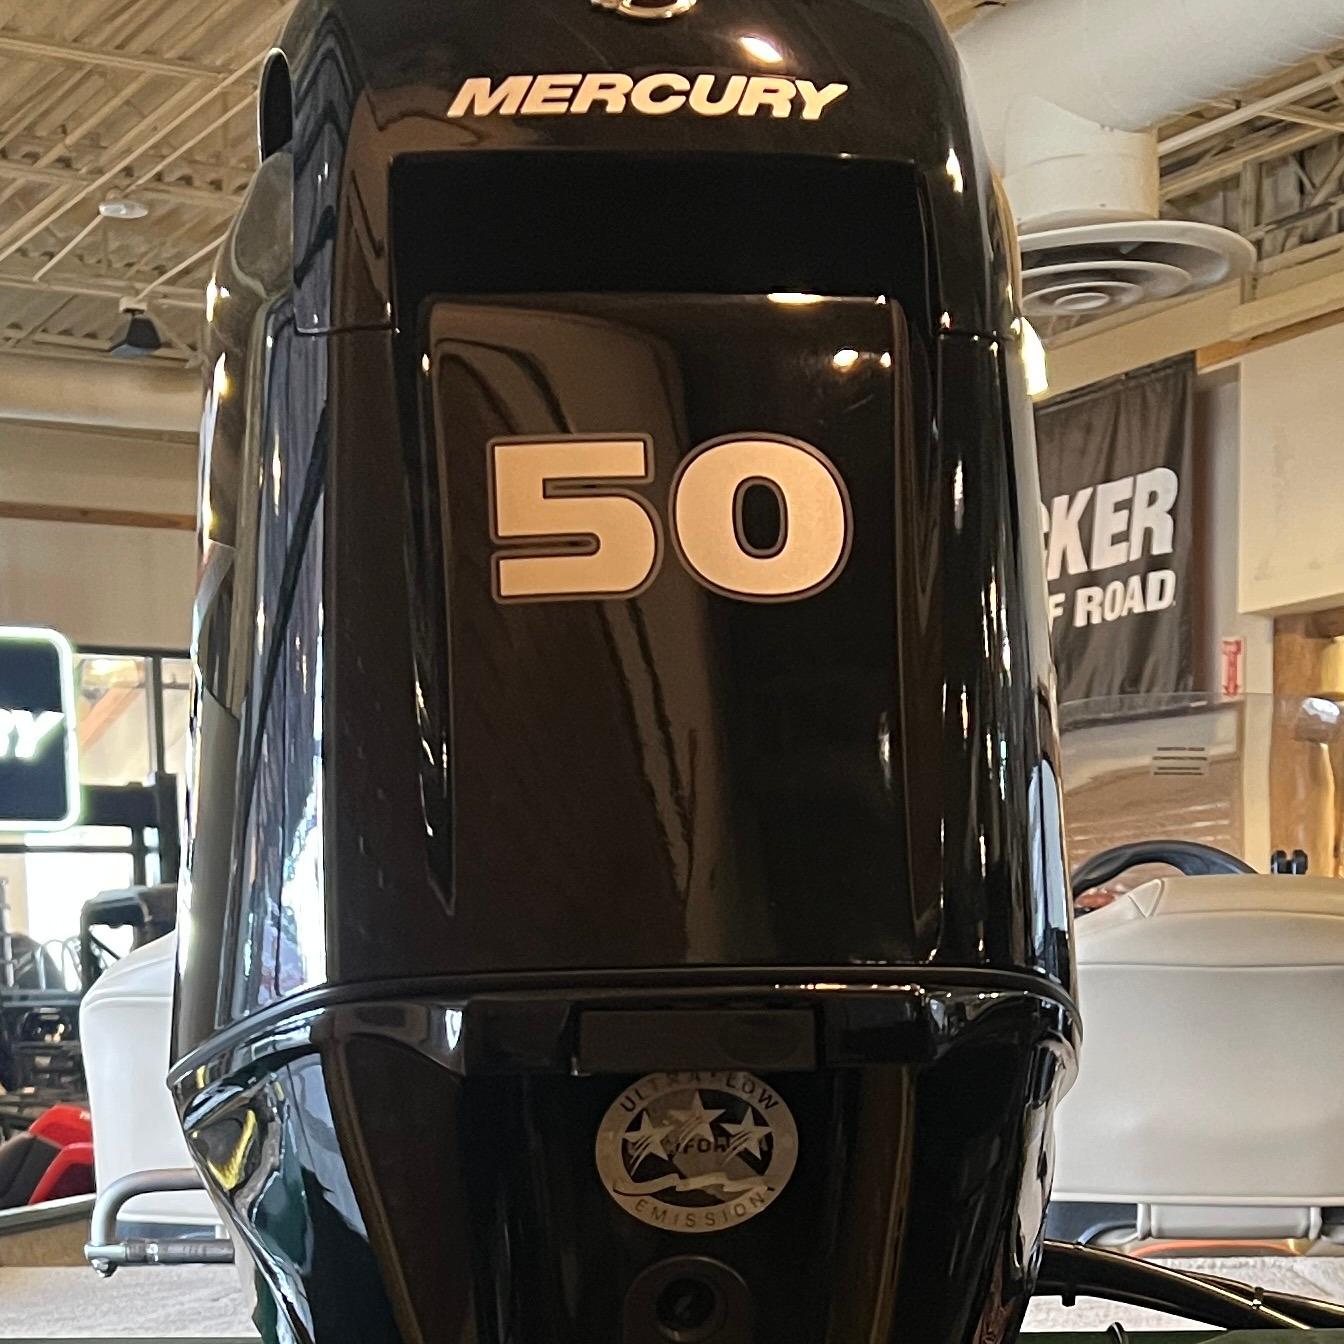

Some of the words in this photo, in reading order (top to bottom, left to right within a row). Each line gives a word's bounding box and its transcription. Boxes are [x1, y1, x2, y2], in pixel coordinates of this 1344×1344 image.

[447, 73, 849, 120] MERCURY
[489, 434, 851, 601] 50
[1041, 467, 1178, 581] KER
[1072, 569, 1177, 628] ROAD
[634, 1192, 767, 1228] EMISSION
